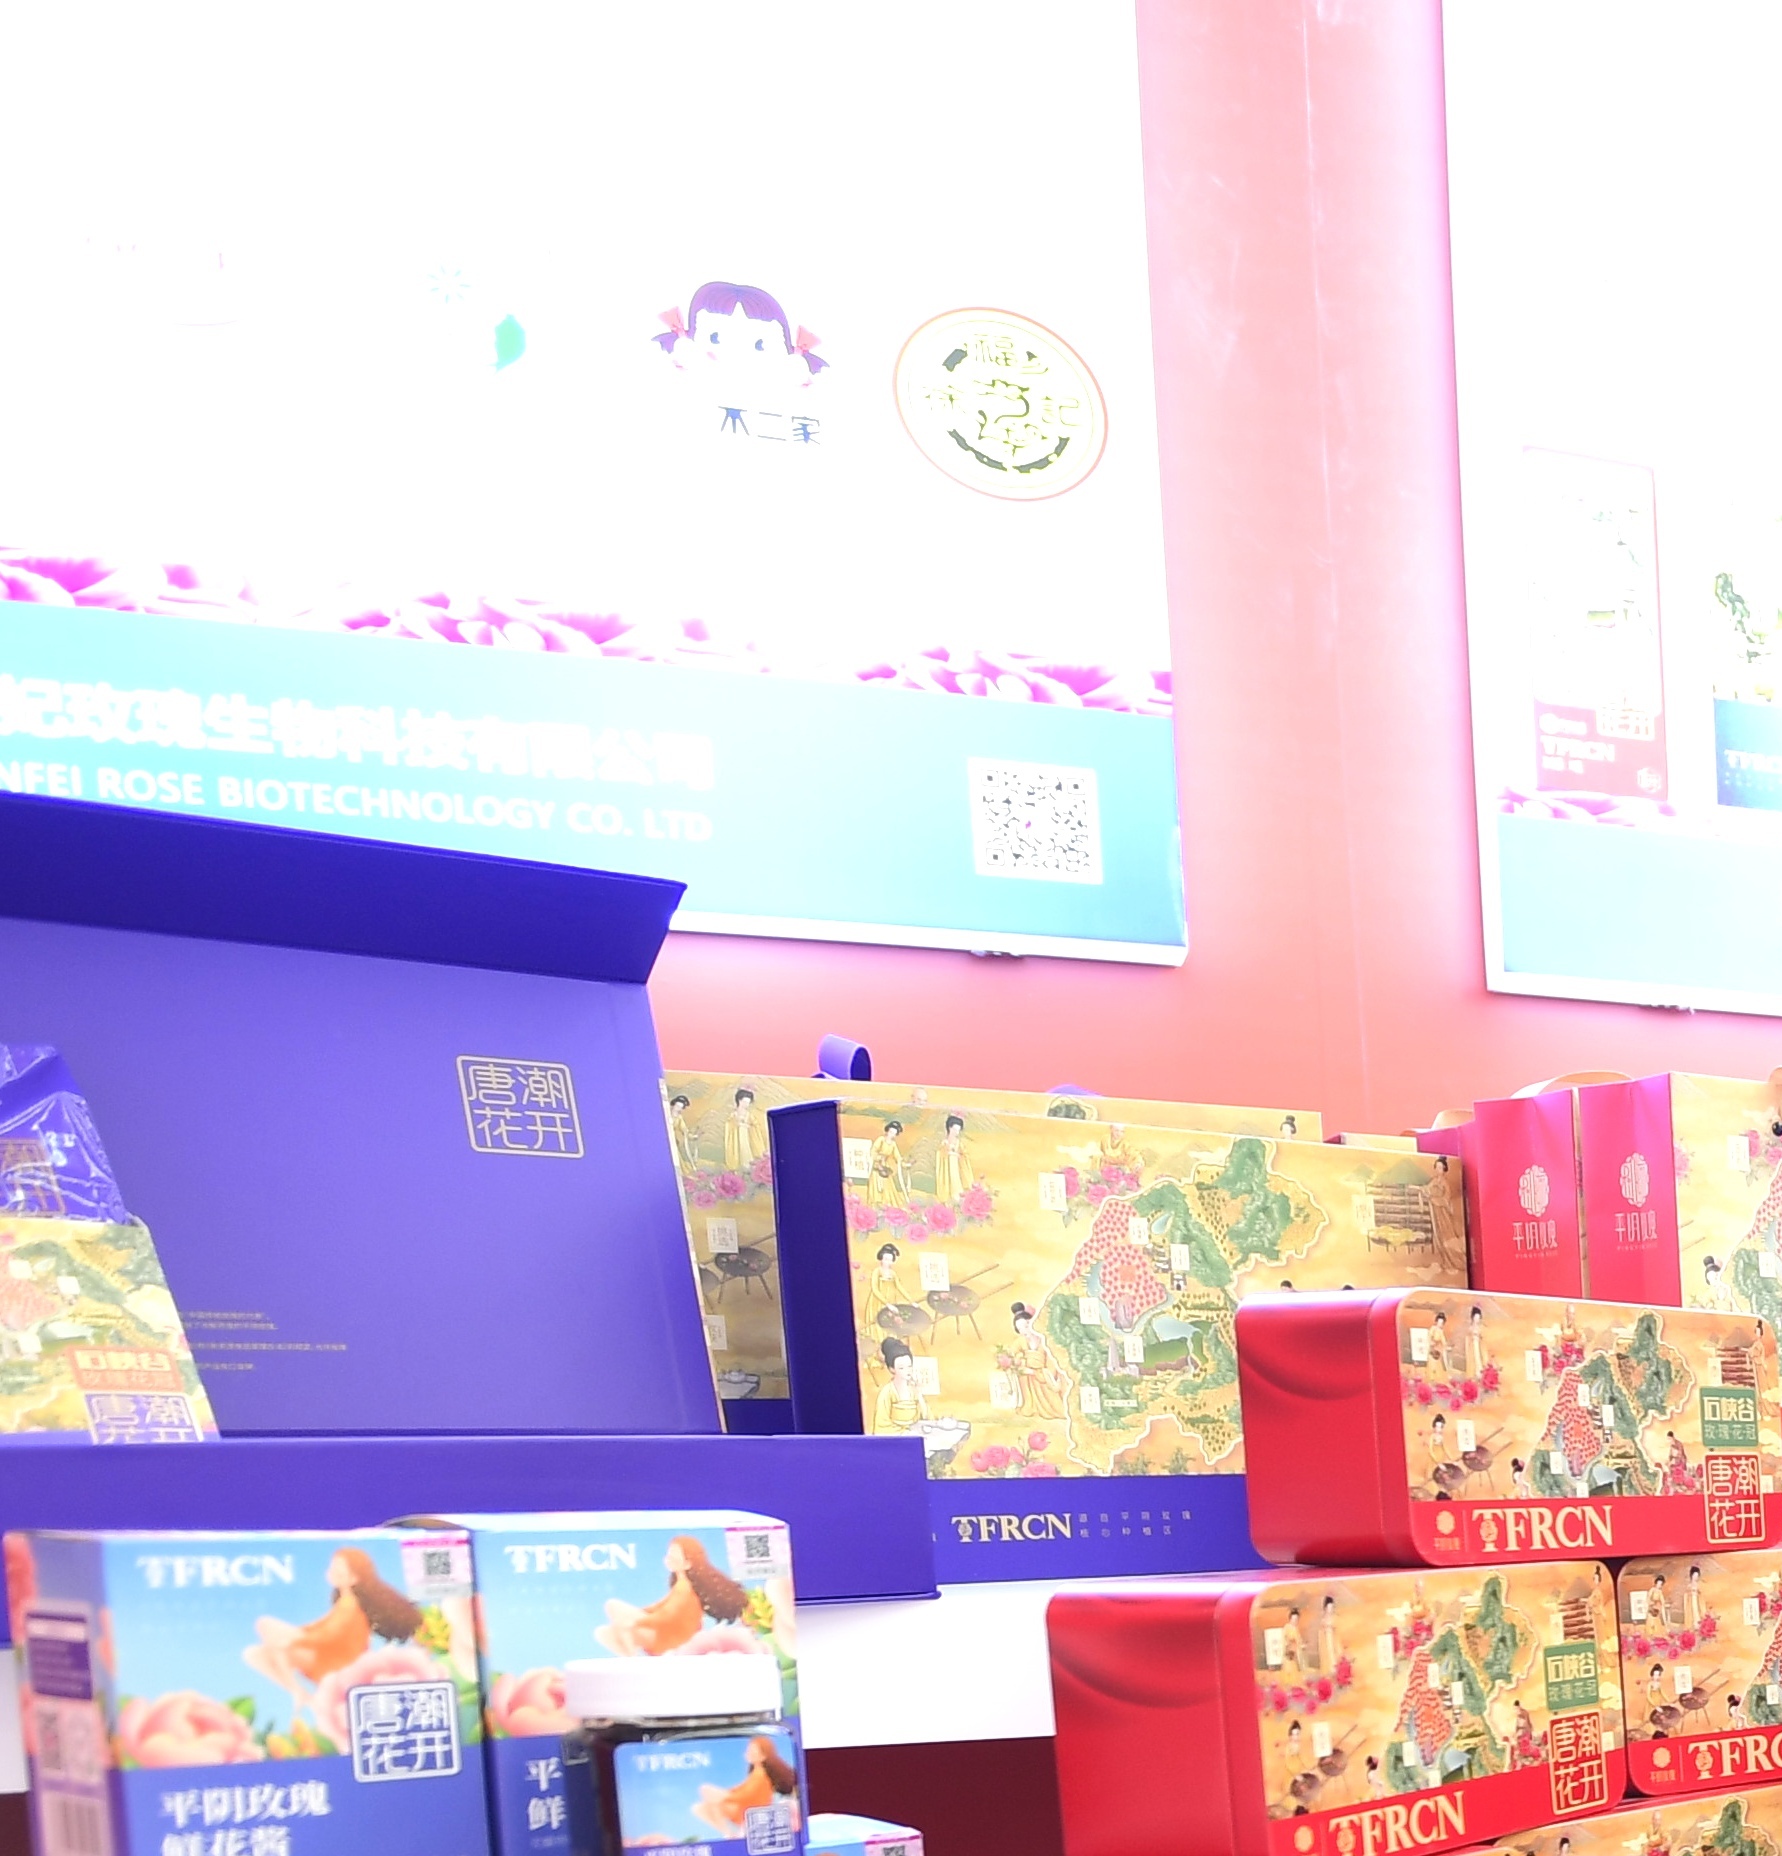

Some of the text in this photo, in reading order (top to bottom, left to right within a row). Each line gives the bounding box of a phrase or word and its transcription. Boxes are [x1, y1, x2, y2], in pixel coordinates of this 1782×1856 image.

[96, 765, 206, 806] ROSE
[217, 774, 556, 829] BIOTECHNOLOGY
[566, 801, 633, 837] CO.
[643, 807, 713, 841] LTD
[468, 1064, 569, 1109] 唐潮
[473, 1106, 573, 1151] 花开
[1703, 1397, 1755, 1421] 石峡谷
[1708, 1457, 1760, 1496] 唐潮
[951, 1513, 1072, 1543] TFRCN
[1472, 1505, 1614, 1553] TFRCN
[1710, 1499, 1761, 1538] 花开
[138, 1555, 295, 1588] TFRCN
[504, 1543, 637, 1574] TFRCN
[1547, 1652, 1595, 1683] 石峡谷
[362, 1730, 452, 1774] 花开
[1551, 1716, 1600, 1763] 唐潮
[161, 1780, 331, 1828] 平阴玫瑰
[1555, 1760, 1603, 1808] 花开
